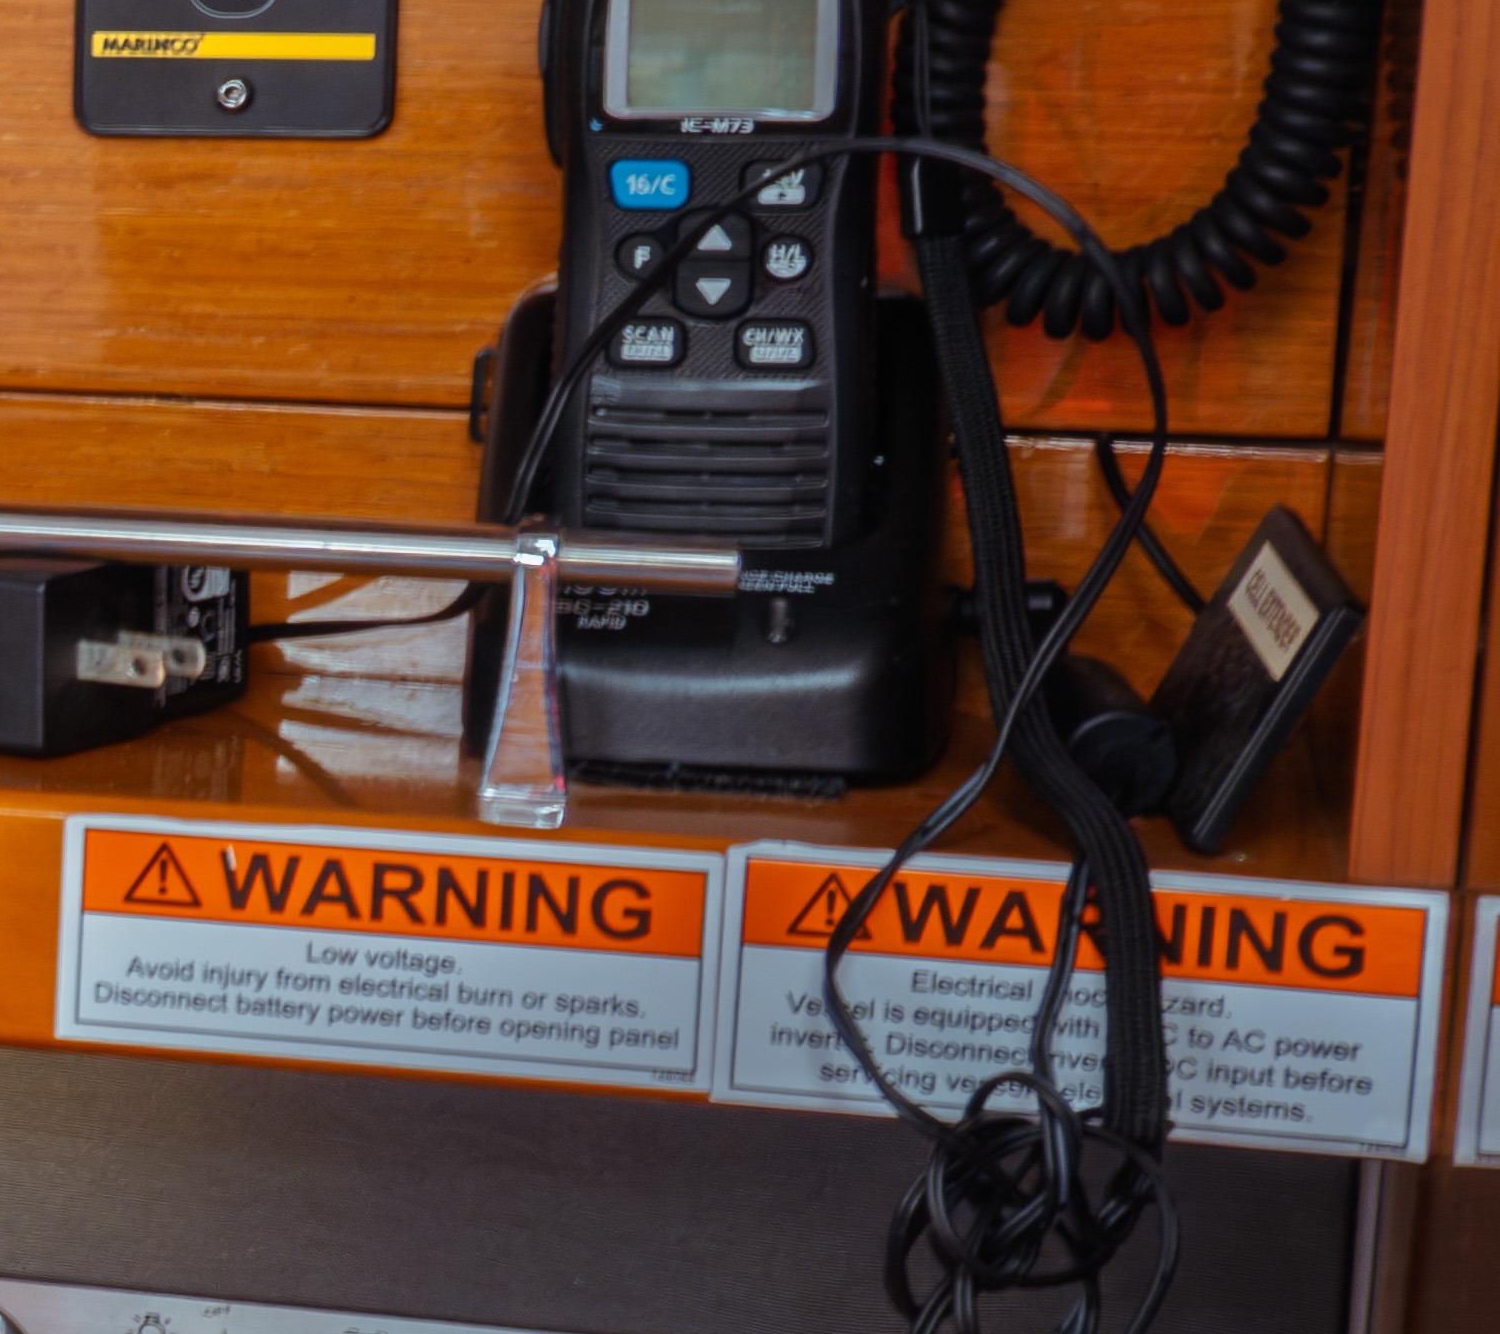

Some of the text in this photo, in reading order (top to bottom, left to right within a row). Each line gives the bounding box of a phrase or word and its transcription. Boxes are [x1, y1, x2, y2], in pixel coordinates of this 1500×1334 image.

[103, 38, 198, 53] MARINCO
[626, 174, 676, 195] 16/C
[622, 326, 674, 344] SCAN
[220, 847, 653, 941] WARNING
[305, 940, 462, 978] Low voltage.
[126, 955, 646, 1019] Avoid injury from electrical burn or sparks.
[910, 969, 1033, 1002] Electrical
[93, 982, 680, 1051] Disconnect battery power before opening panel
[884, 1001, 904, 1022] is
[1187, 1027, 1214, 1050] to
[1221, 1030, 1267, 1054] AC
[1273, 1037, 1363, 1062] power
[1206, 1061, 1373, 1095] input before
[1189, 1095, 1312, 1123] systems.
